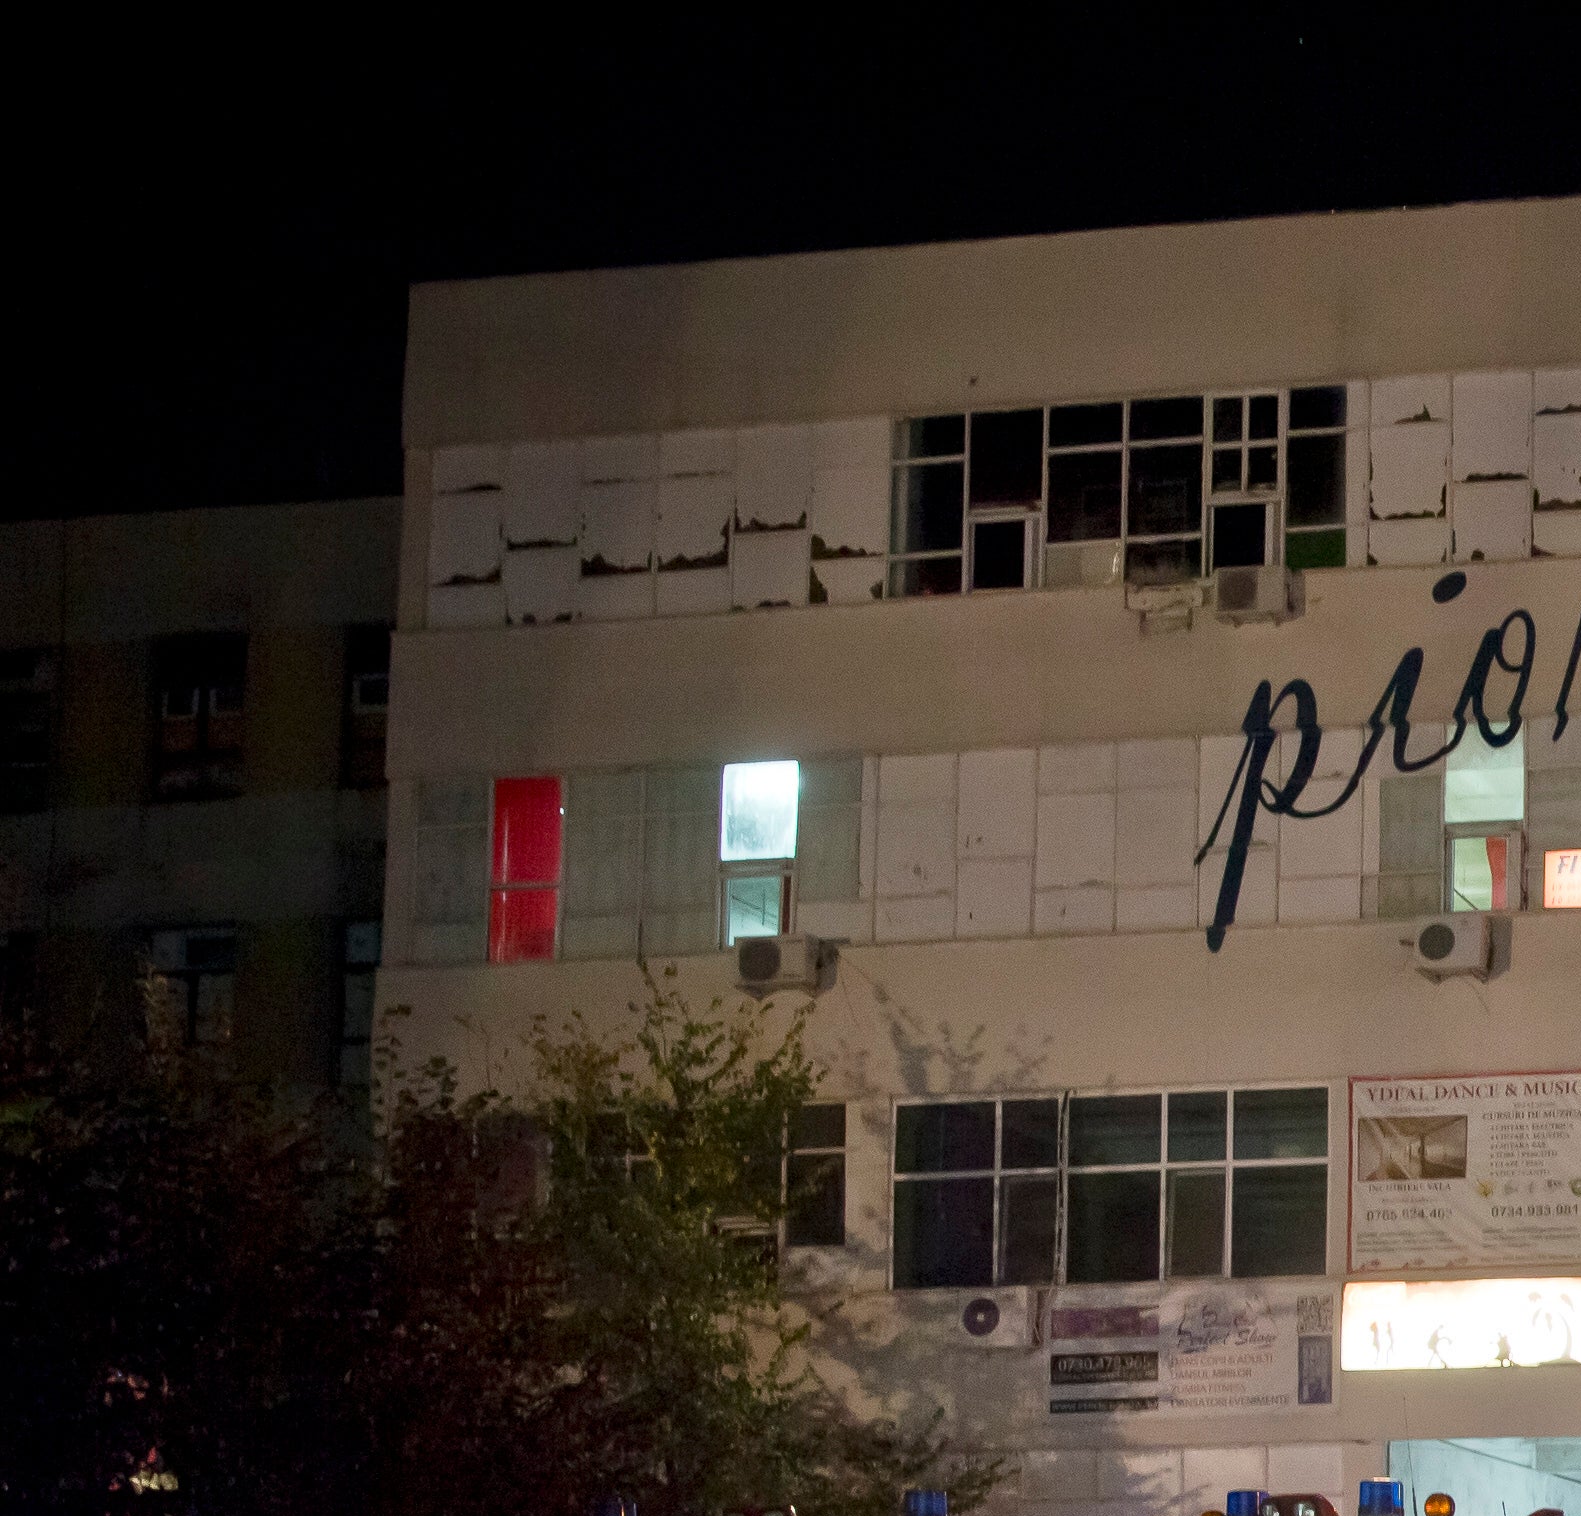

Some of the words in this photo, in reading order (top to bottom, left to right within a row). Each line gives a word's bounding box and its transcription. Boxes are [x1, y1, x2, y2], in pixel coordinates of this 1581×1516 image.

[1368, 1086, 1429, 1101] YDEAL
[1435, 1083, 1496, 1099] DANCE
[1504, 1083, 1518, 1097] &
